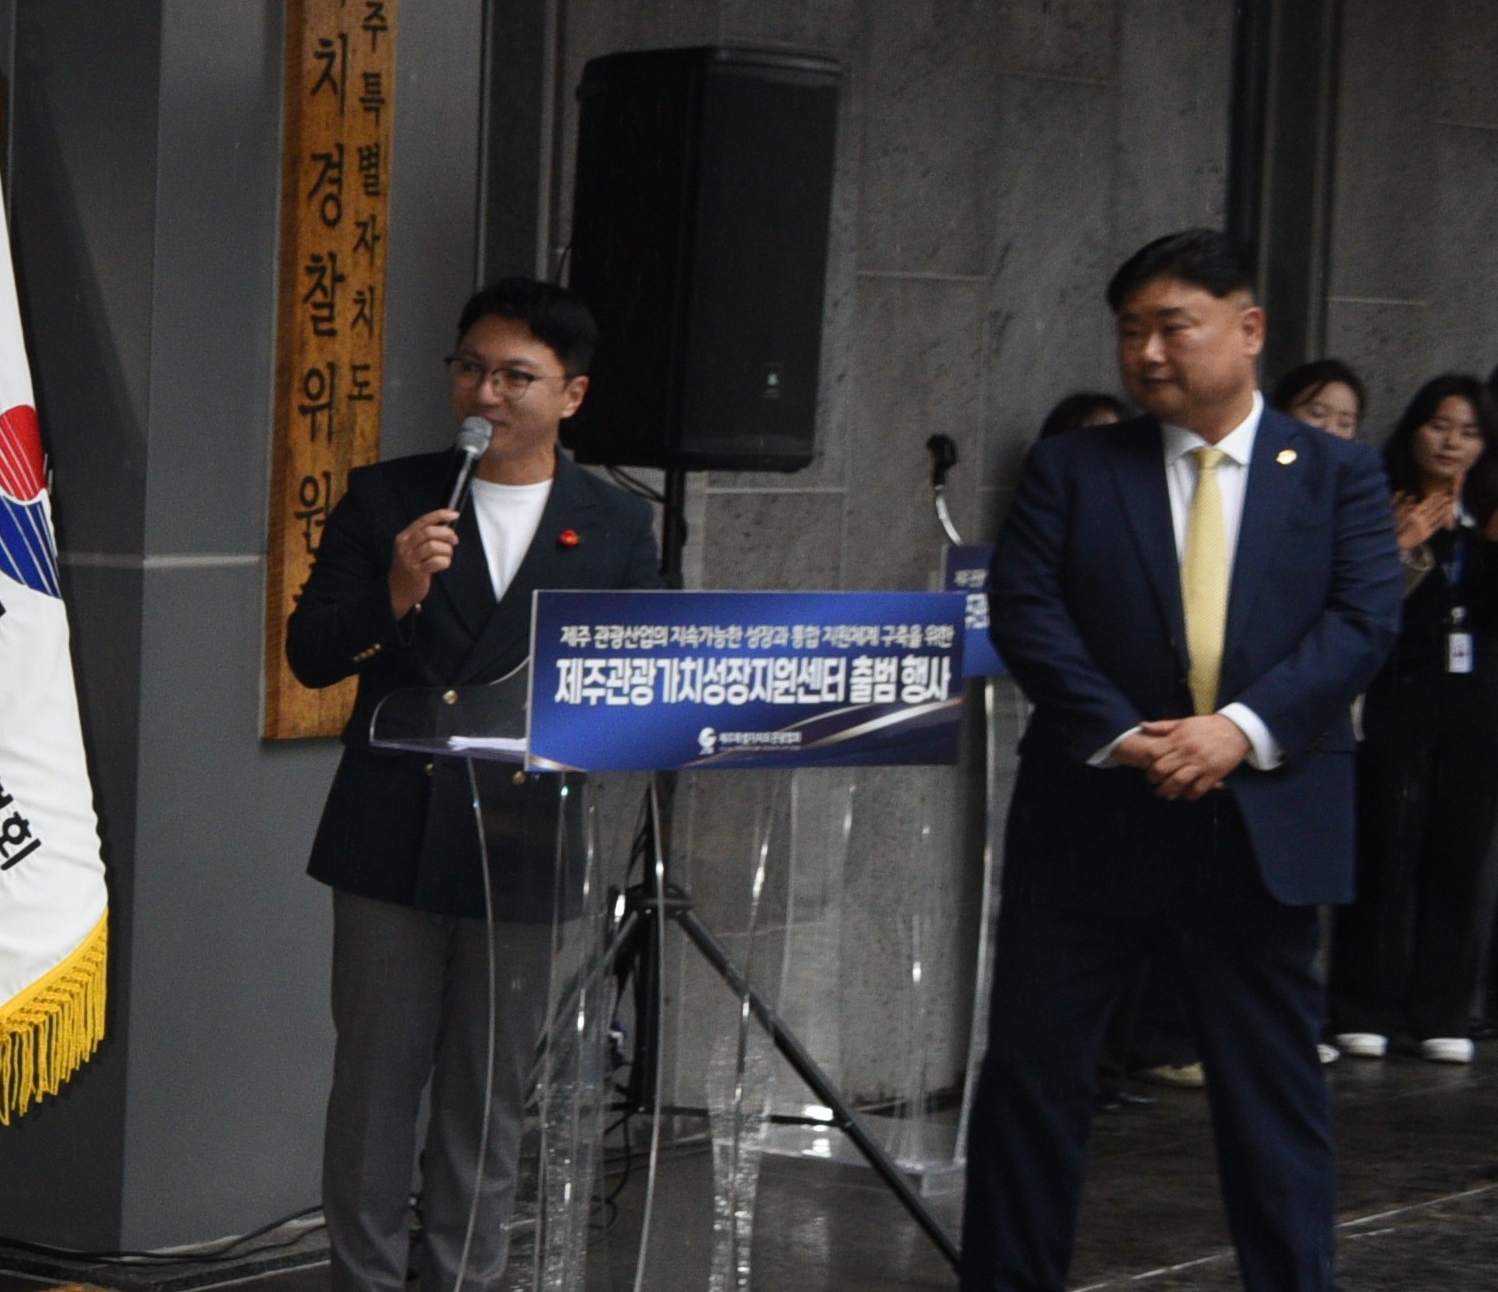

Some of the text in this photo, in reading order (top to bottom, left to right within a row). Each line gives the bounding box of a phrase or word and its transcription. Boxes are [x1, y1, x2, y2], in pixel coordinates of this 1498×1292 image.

[560, 625, 591, 648] 제주
[593, 625, 669, 649] 관광산업의
[670, 625, 742, 649] 지속가능한
[554, 654, 952, 707] 제주관광가치성장지원센터 출범 행사
